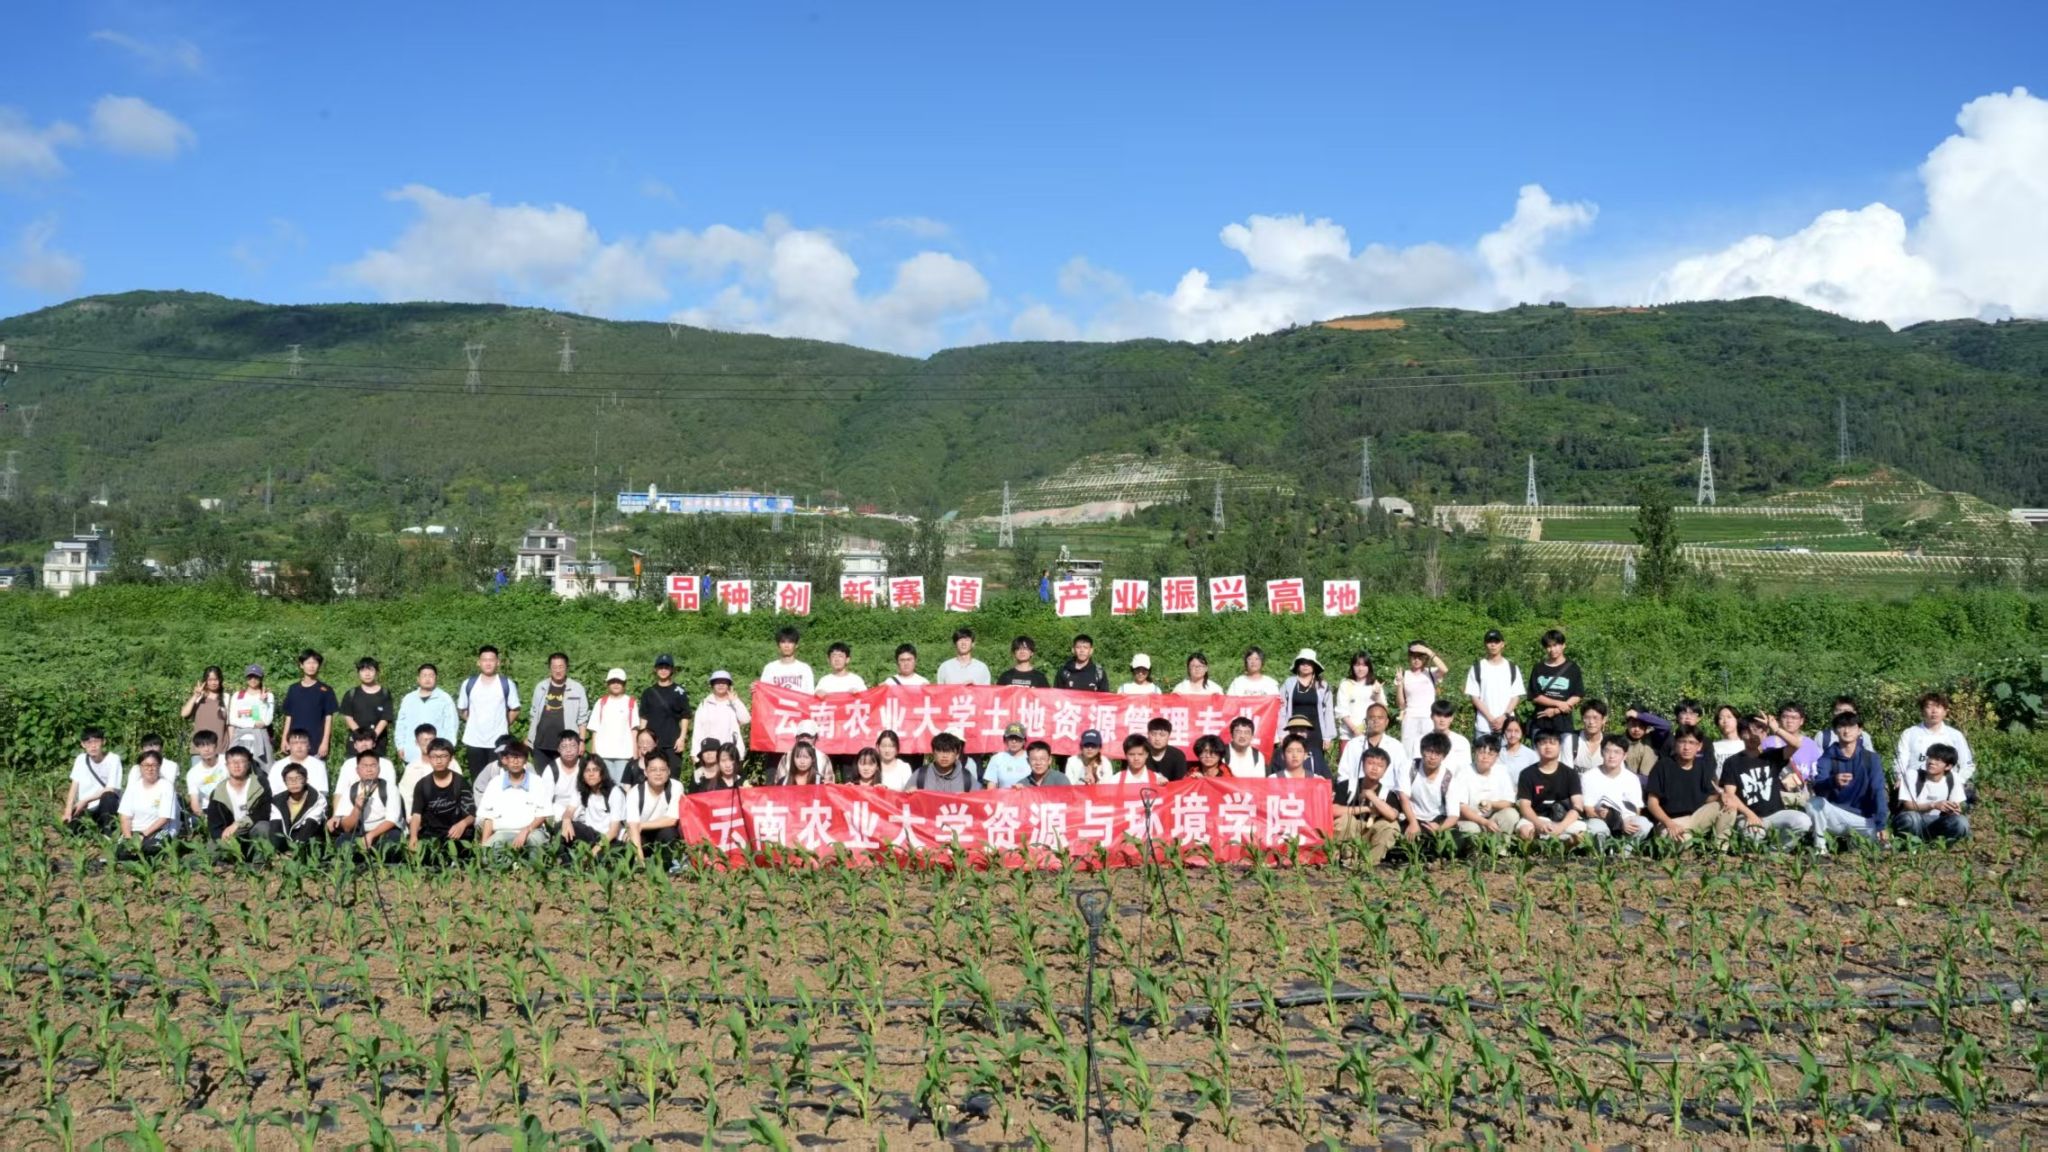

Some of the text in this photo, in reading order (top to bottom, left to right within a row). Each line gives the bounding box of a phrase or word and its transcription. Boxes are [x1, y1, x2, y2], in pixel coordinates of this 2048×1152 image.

[668, 577, 1359, 616] 品种创新赛道 产业振兴高地
[709, 792, 1307, 852] 云南农业大学资源与环境学院
